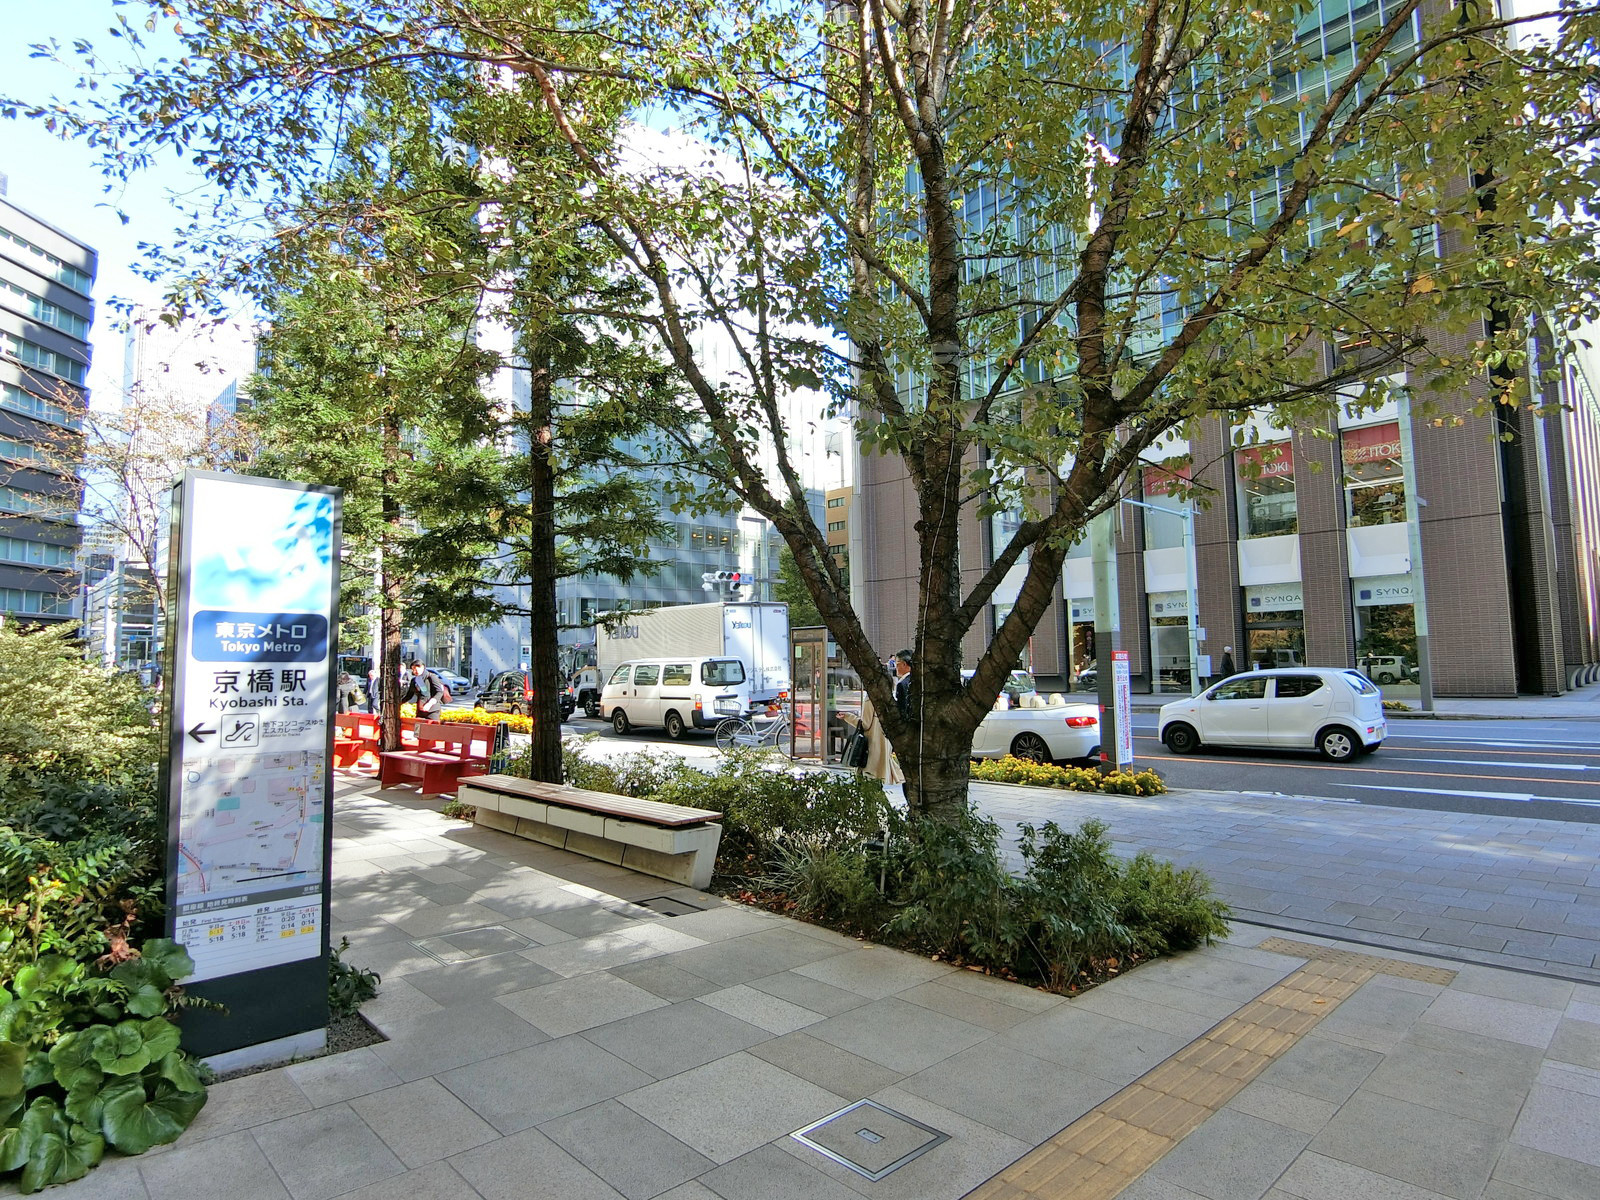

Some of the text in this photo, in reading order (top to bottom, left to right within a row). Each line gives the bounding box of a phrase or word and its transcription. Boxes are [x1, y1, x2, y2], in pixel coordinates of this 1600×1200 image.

[1369, 443, 1400, 458] ITOK
[1261, 461, 1289, 475] TOKI
[1265, 595, 1302, 604] SYNQA
[215, 622, 307, 639] 東京メトロ
[220, 640, 301, 654] Tokyo Metro
[213, 669, 306, 693] 京橋駅
[209, 696, 308, 711] Kyobashi Sta.
[262, 719, 324, 728] 地下コンコースゆき
[263, 726, 312, 734] エスカレーター
[231, 924, 246, 932] 5:16
[209, 935, 224, 943] 5:18
[231, 931, 246, 939] 5:18
